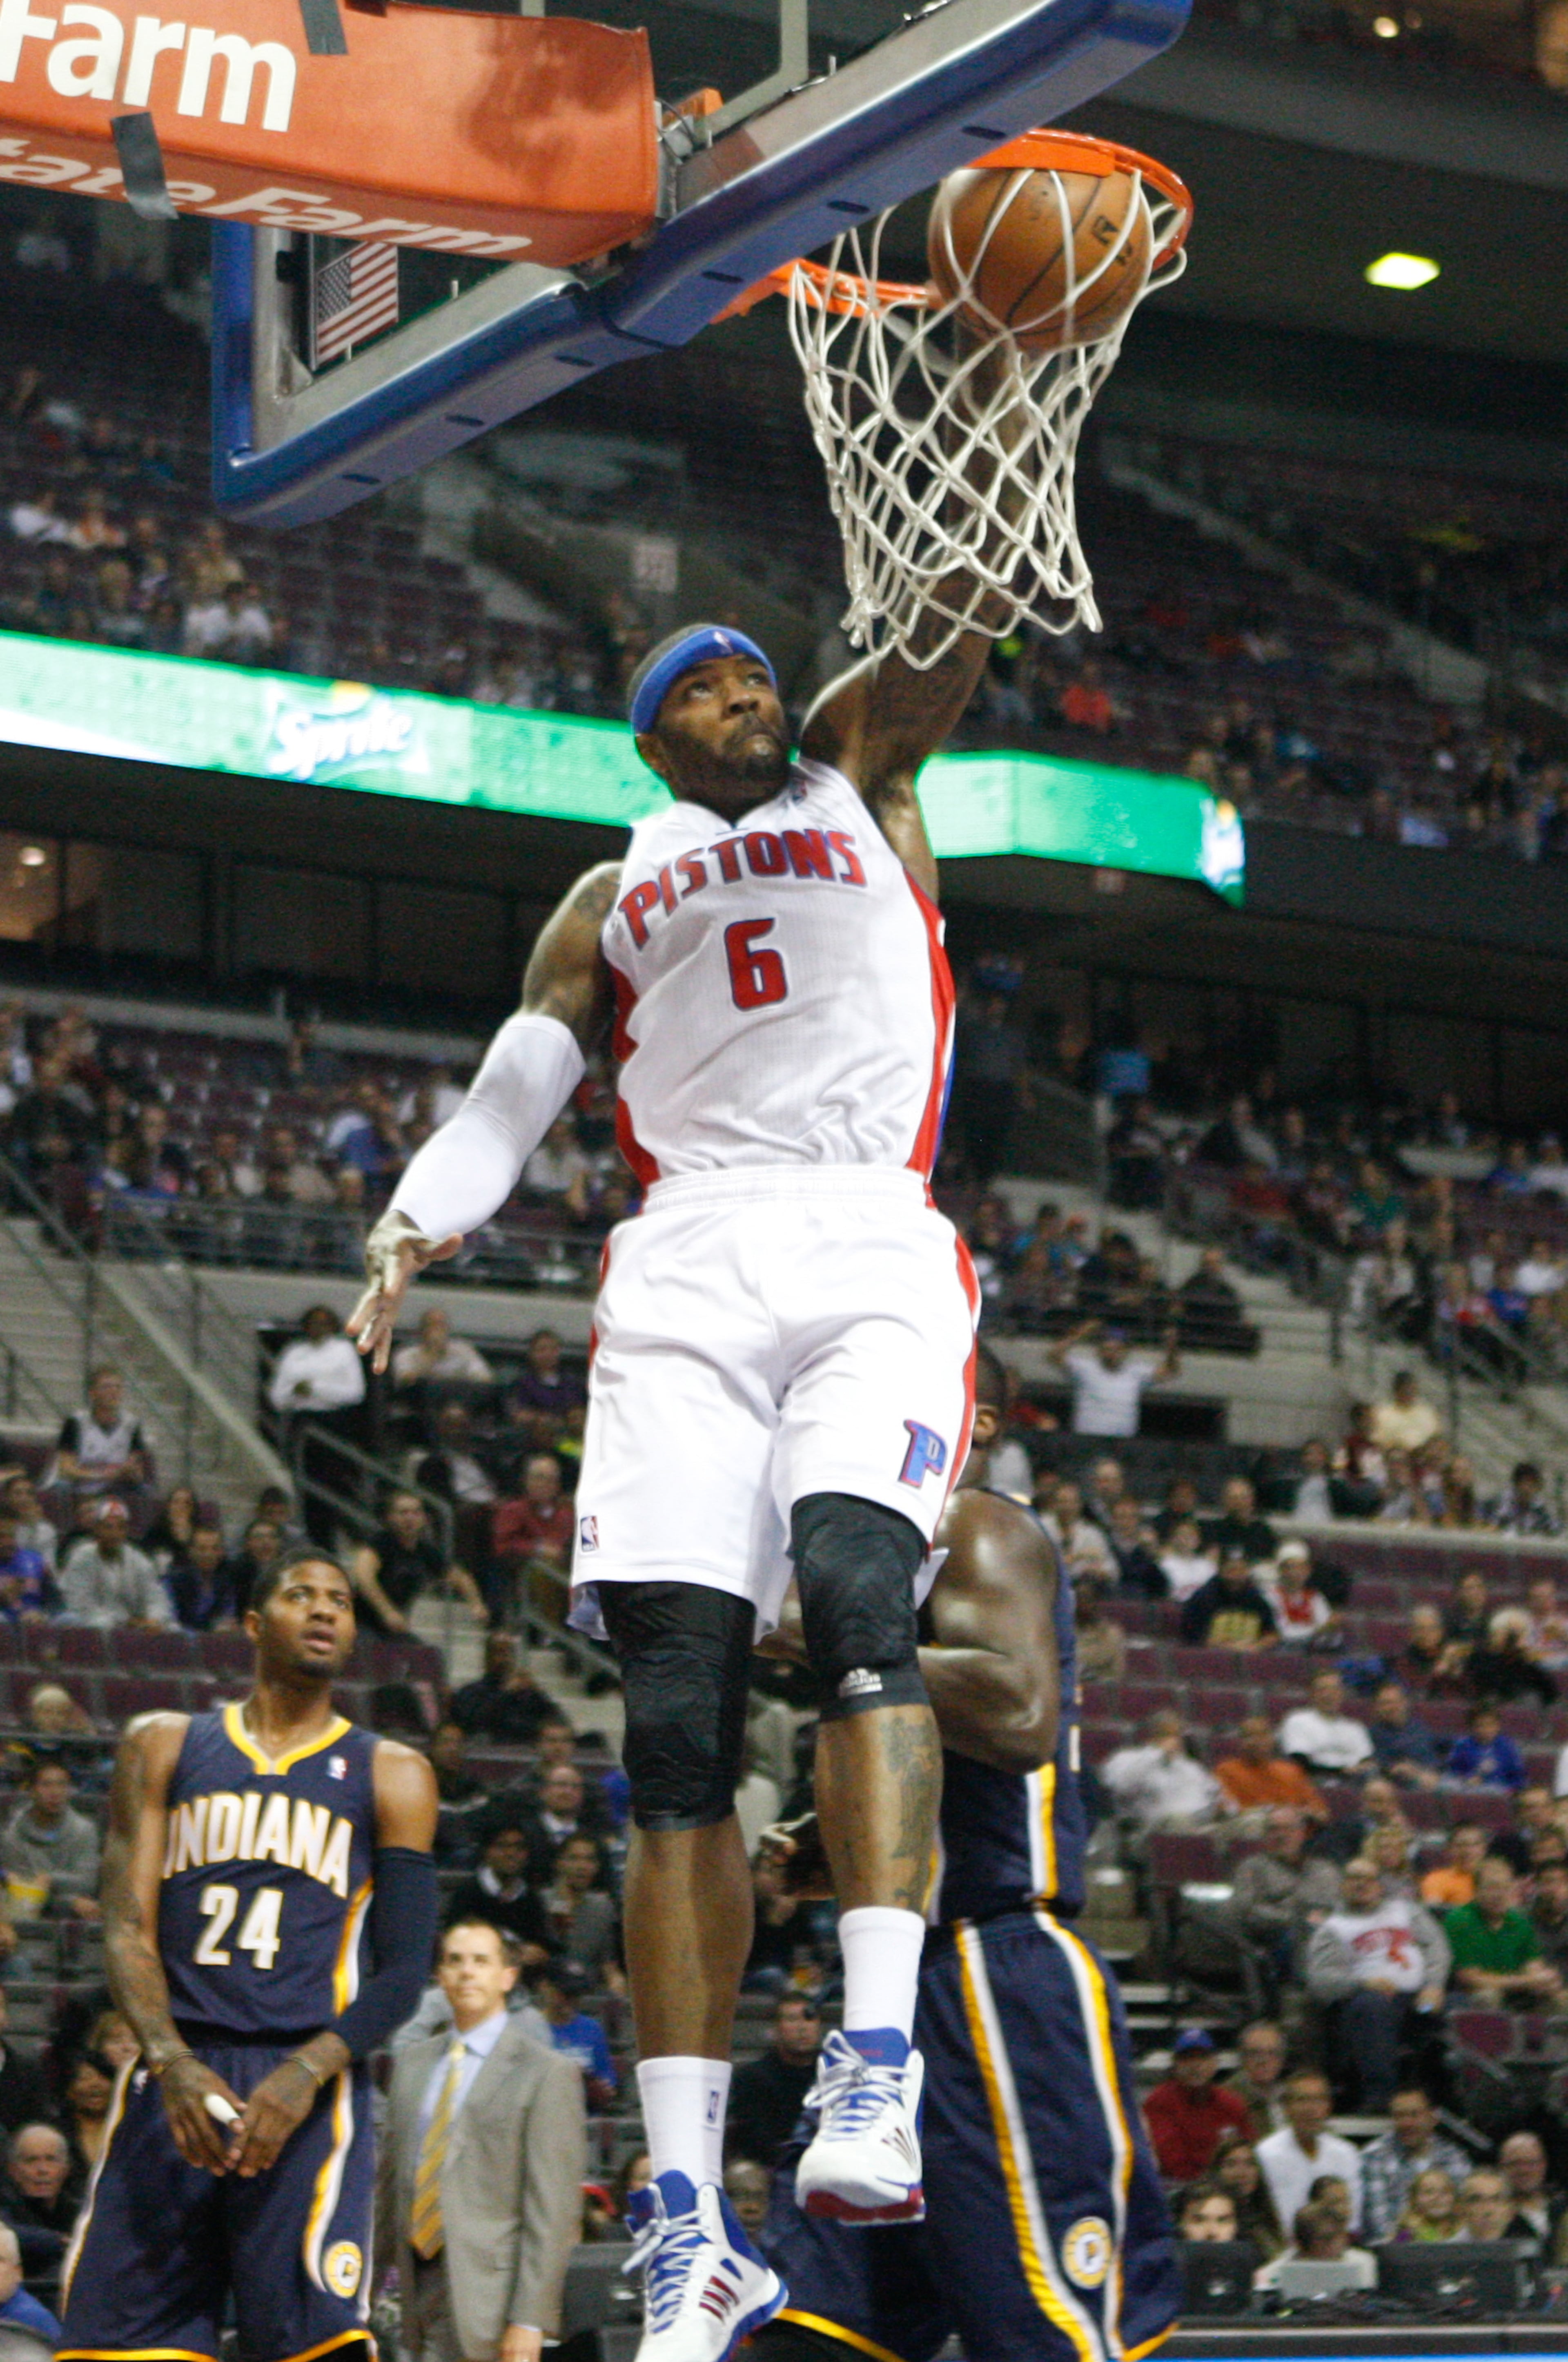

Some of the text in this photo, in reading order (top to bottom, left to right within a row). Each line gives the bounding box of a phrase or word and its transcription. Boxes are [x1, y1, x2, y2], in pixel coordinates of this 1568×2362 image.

[196, 187, 532, 255] Farm
[617, 828, 867, 951] PISTONS
[724, 917, 788, 1011] 6
[163, 1791, 353, 1898] INDIANA
[194, 1884, 283, 1969] 24
